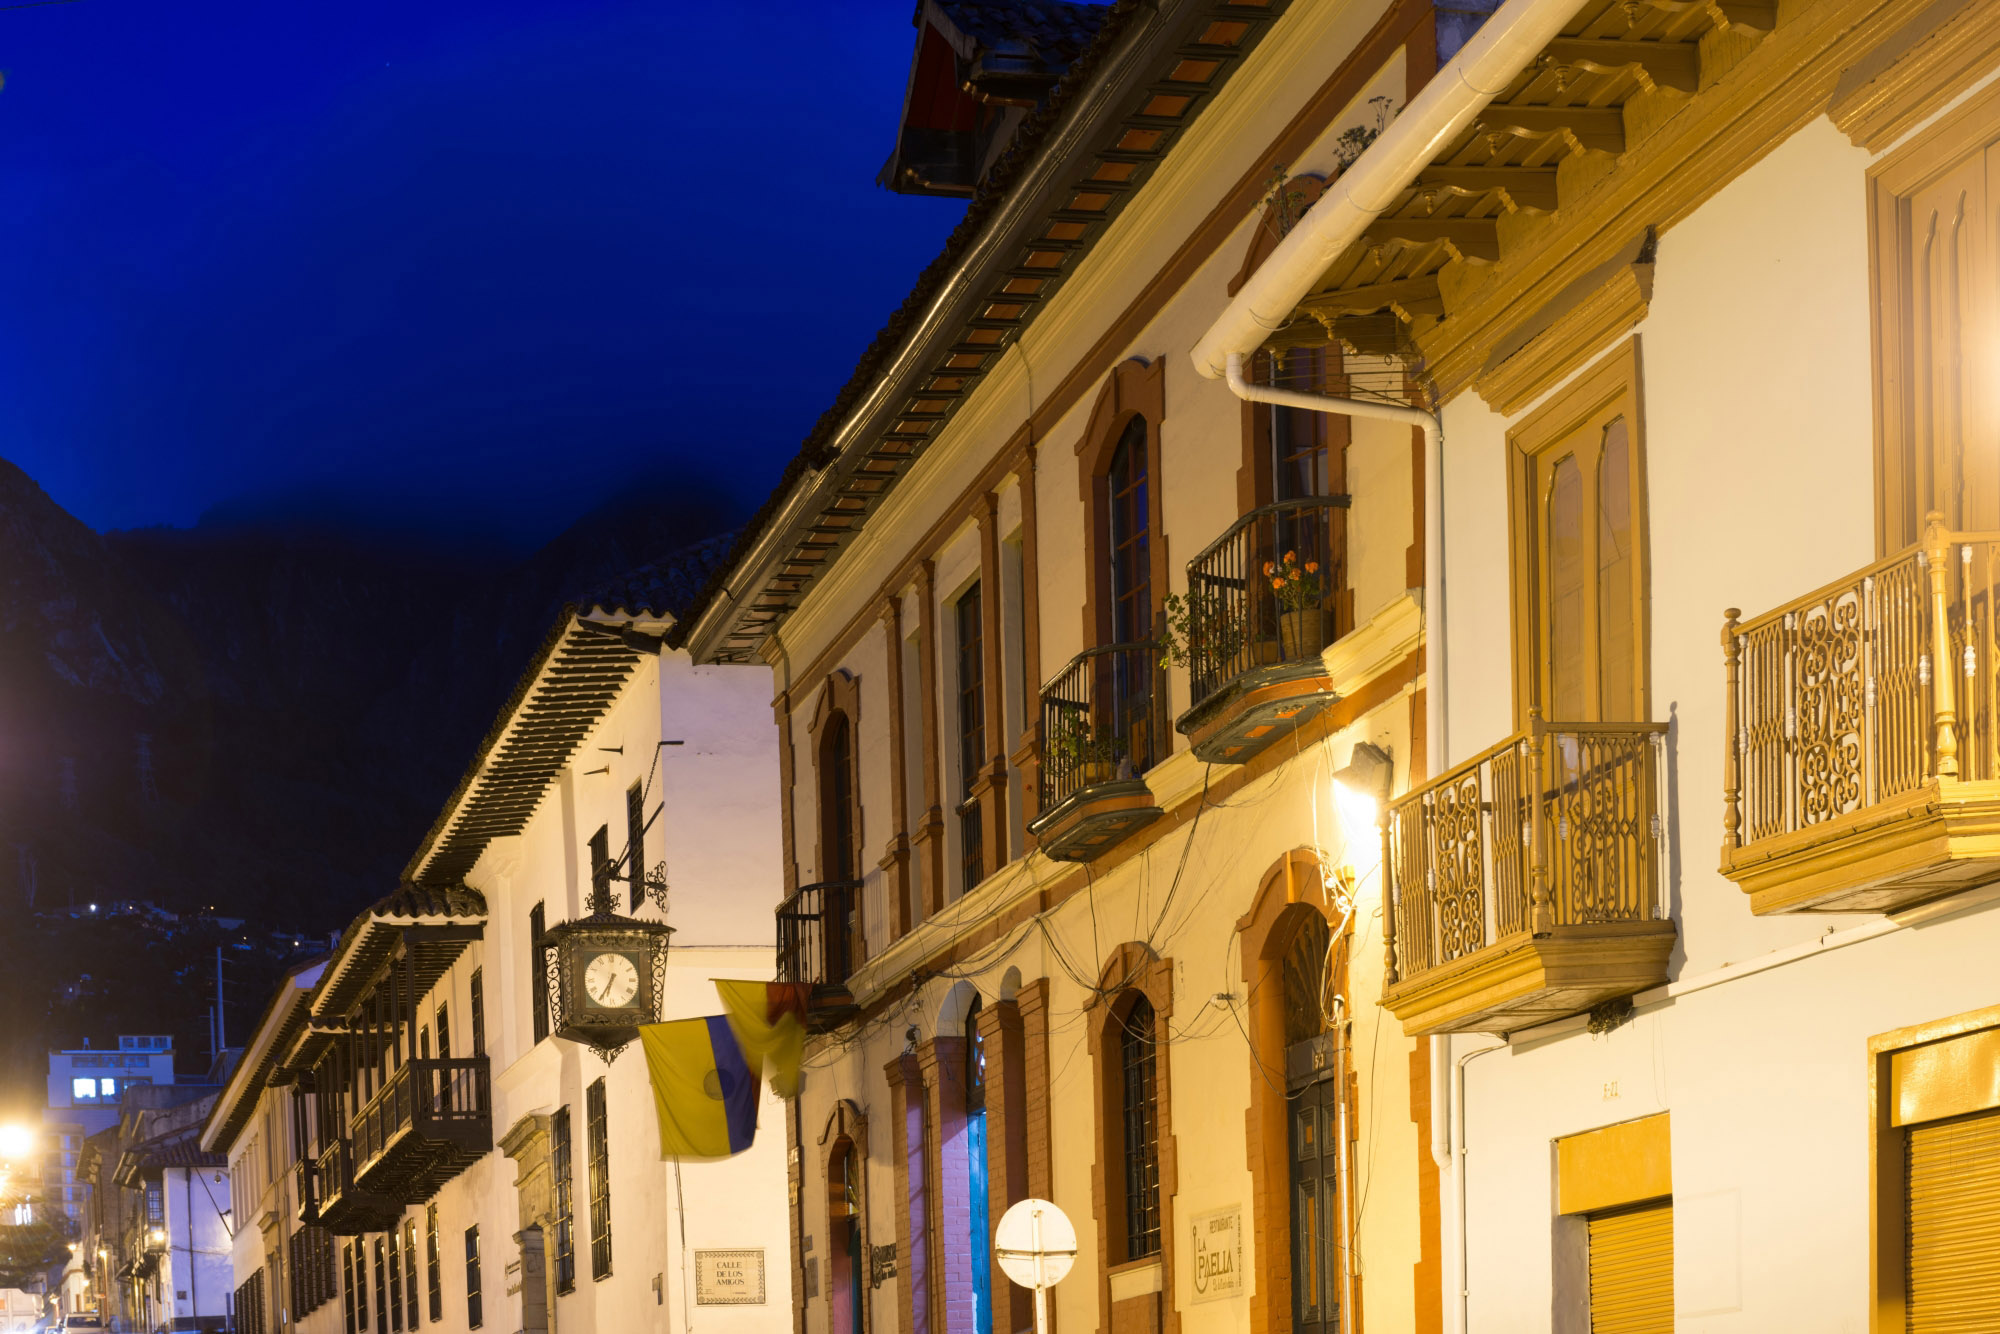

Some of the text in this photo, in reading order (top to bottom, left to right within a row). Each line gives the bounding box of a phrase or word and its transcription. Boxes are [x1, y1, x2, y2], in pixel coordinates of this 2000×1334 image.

[1198, 1238, 1206, 1253] LA
[716, 1261, 743, 1269] CALLE
[1198, 1248, 1234, 1279] PAELLA
[716, 1270, 743, 1278] DE LOS
[716, 1278, 745, 1286] AMIGOS
